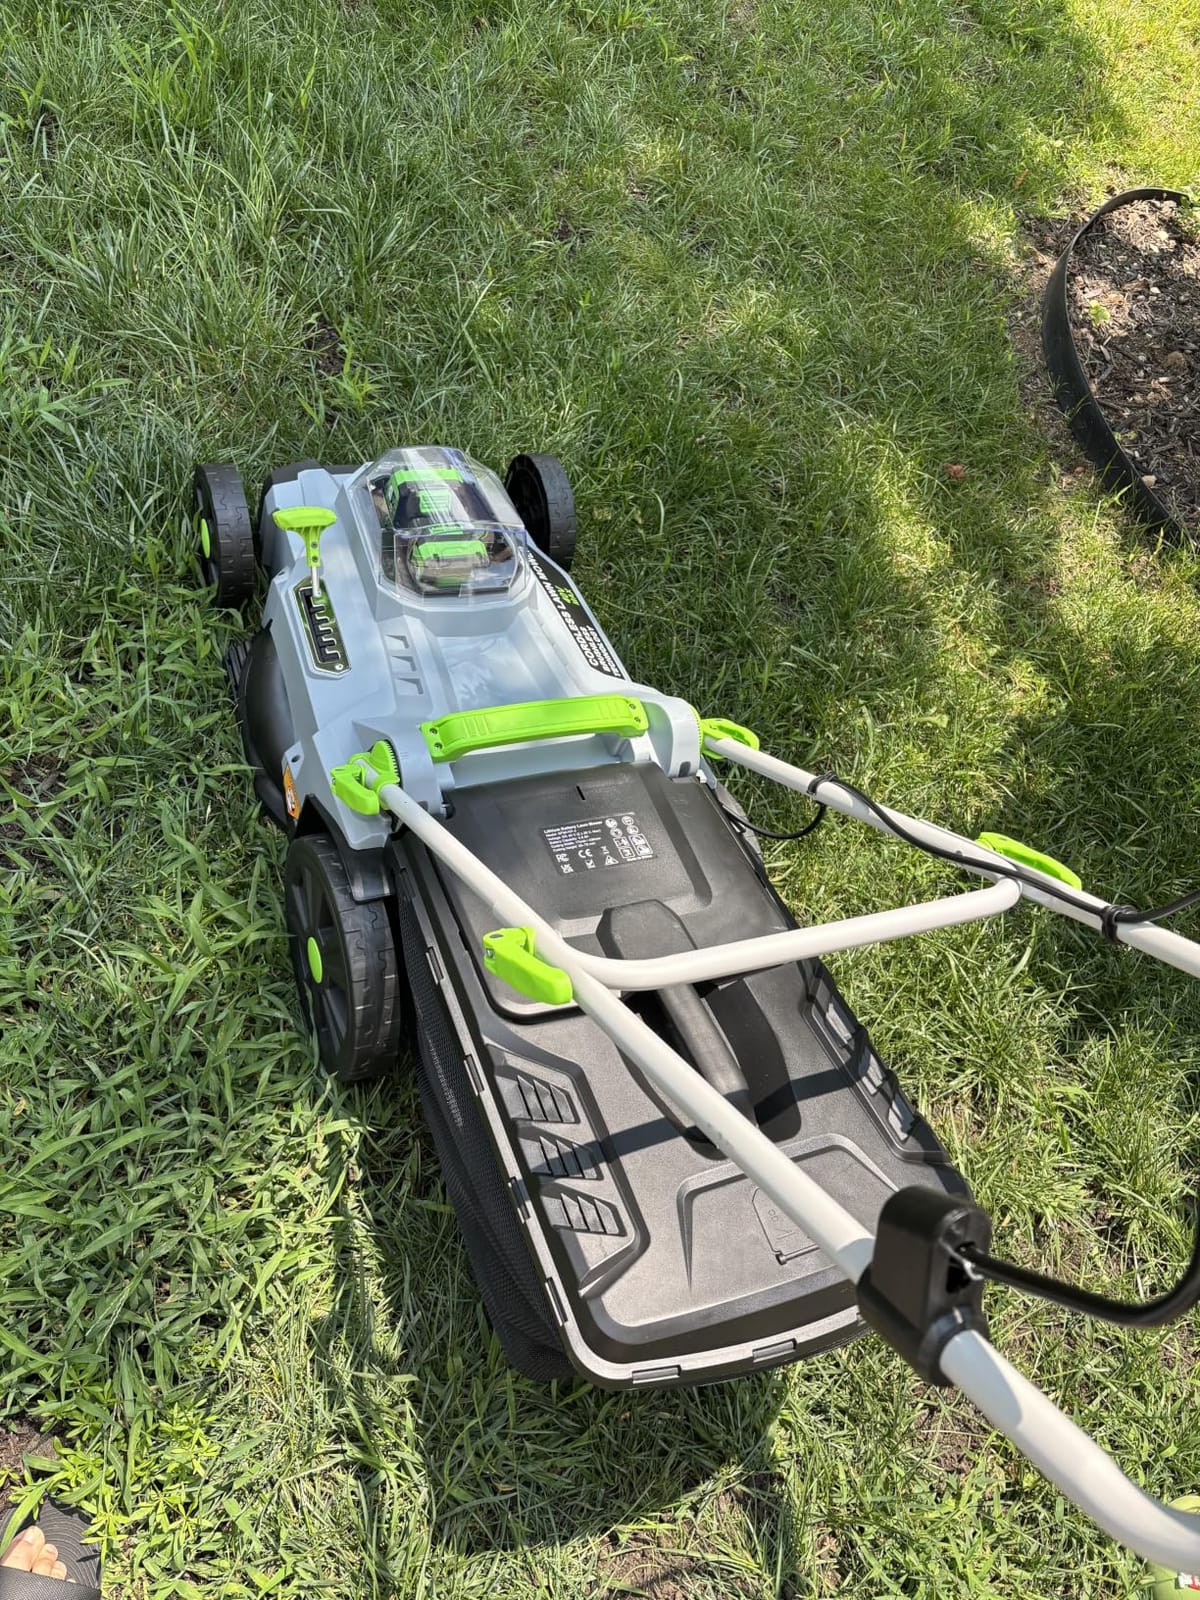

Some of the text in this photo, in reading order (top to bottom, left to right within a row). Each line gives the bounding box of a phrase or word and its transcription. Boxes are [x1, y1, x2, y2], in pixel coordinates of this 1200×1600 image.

[543, 581, 566, 610] LAWN
[561, 611, 599, 667] CORDLESS
[580, 626, 611, 673] BRUSHLESS
[586, 625, 621, 677] TECHNOLOGY
[578, 848, 593, 858] CE
